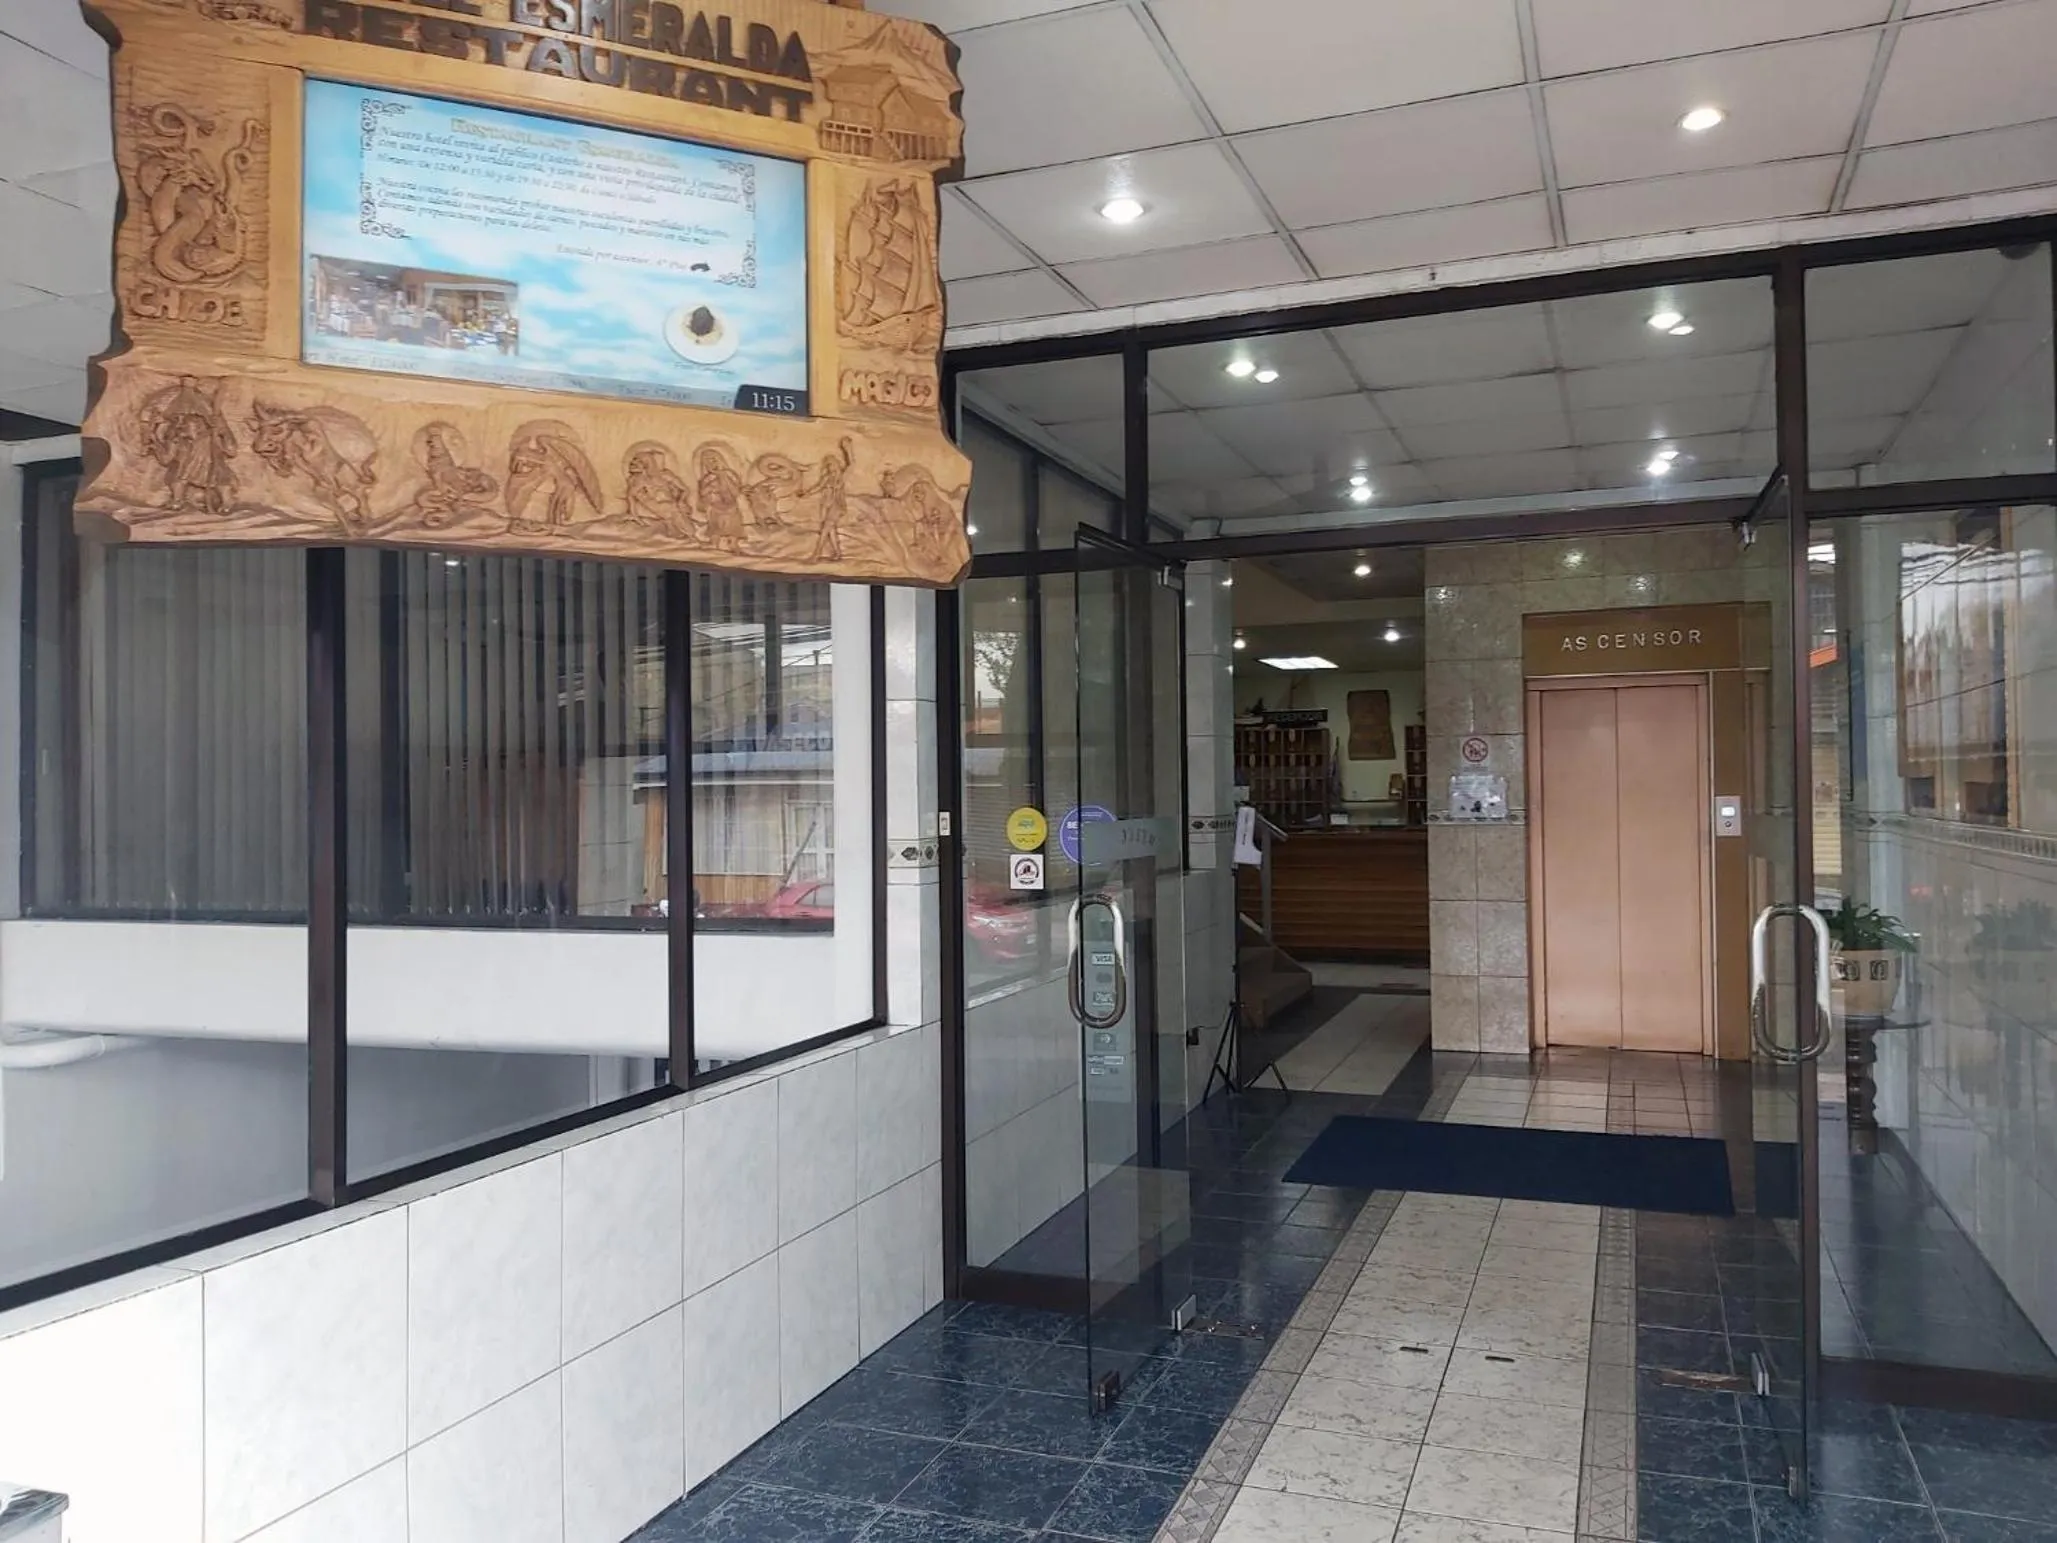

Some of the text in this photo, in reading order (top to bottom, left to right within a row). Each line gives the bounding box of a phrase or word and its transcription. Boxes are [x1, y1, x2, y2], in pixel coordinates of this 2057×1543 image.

[304, 0, 813, 122] RESTAURANT
[511, 0, 813, 83] ESMERALDA
[426, 133, 453, 145] hotel
[752, 391, 796, 411] 11:15
